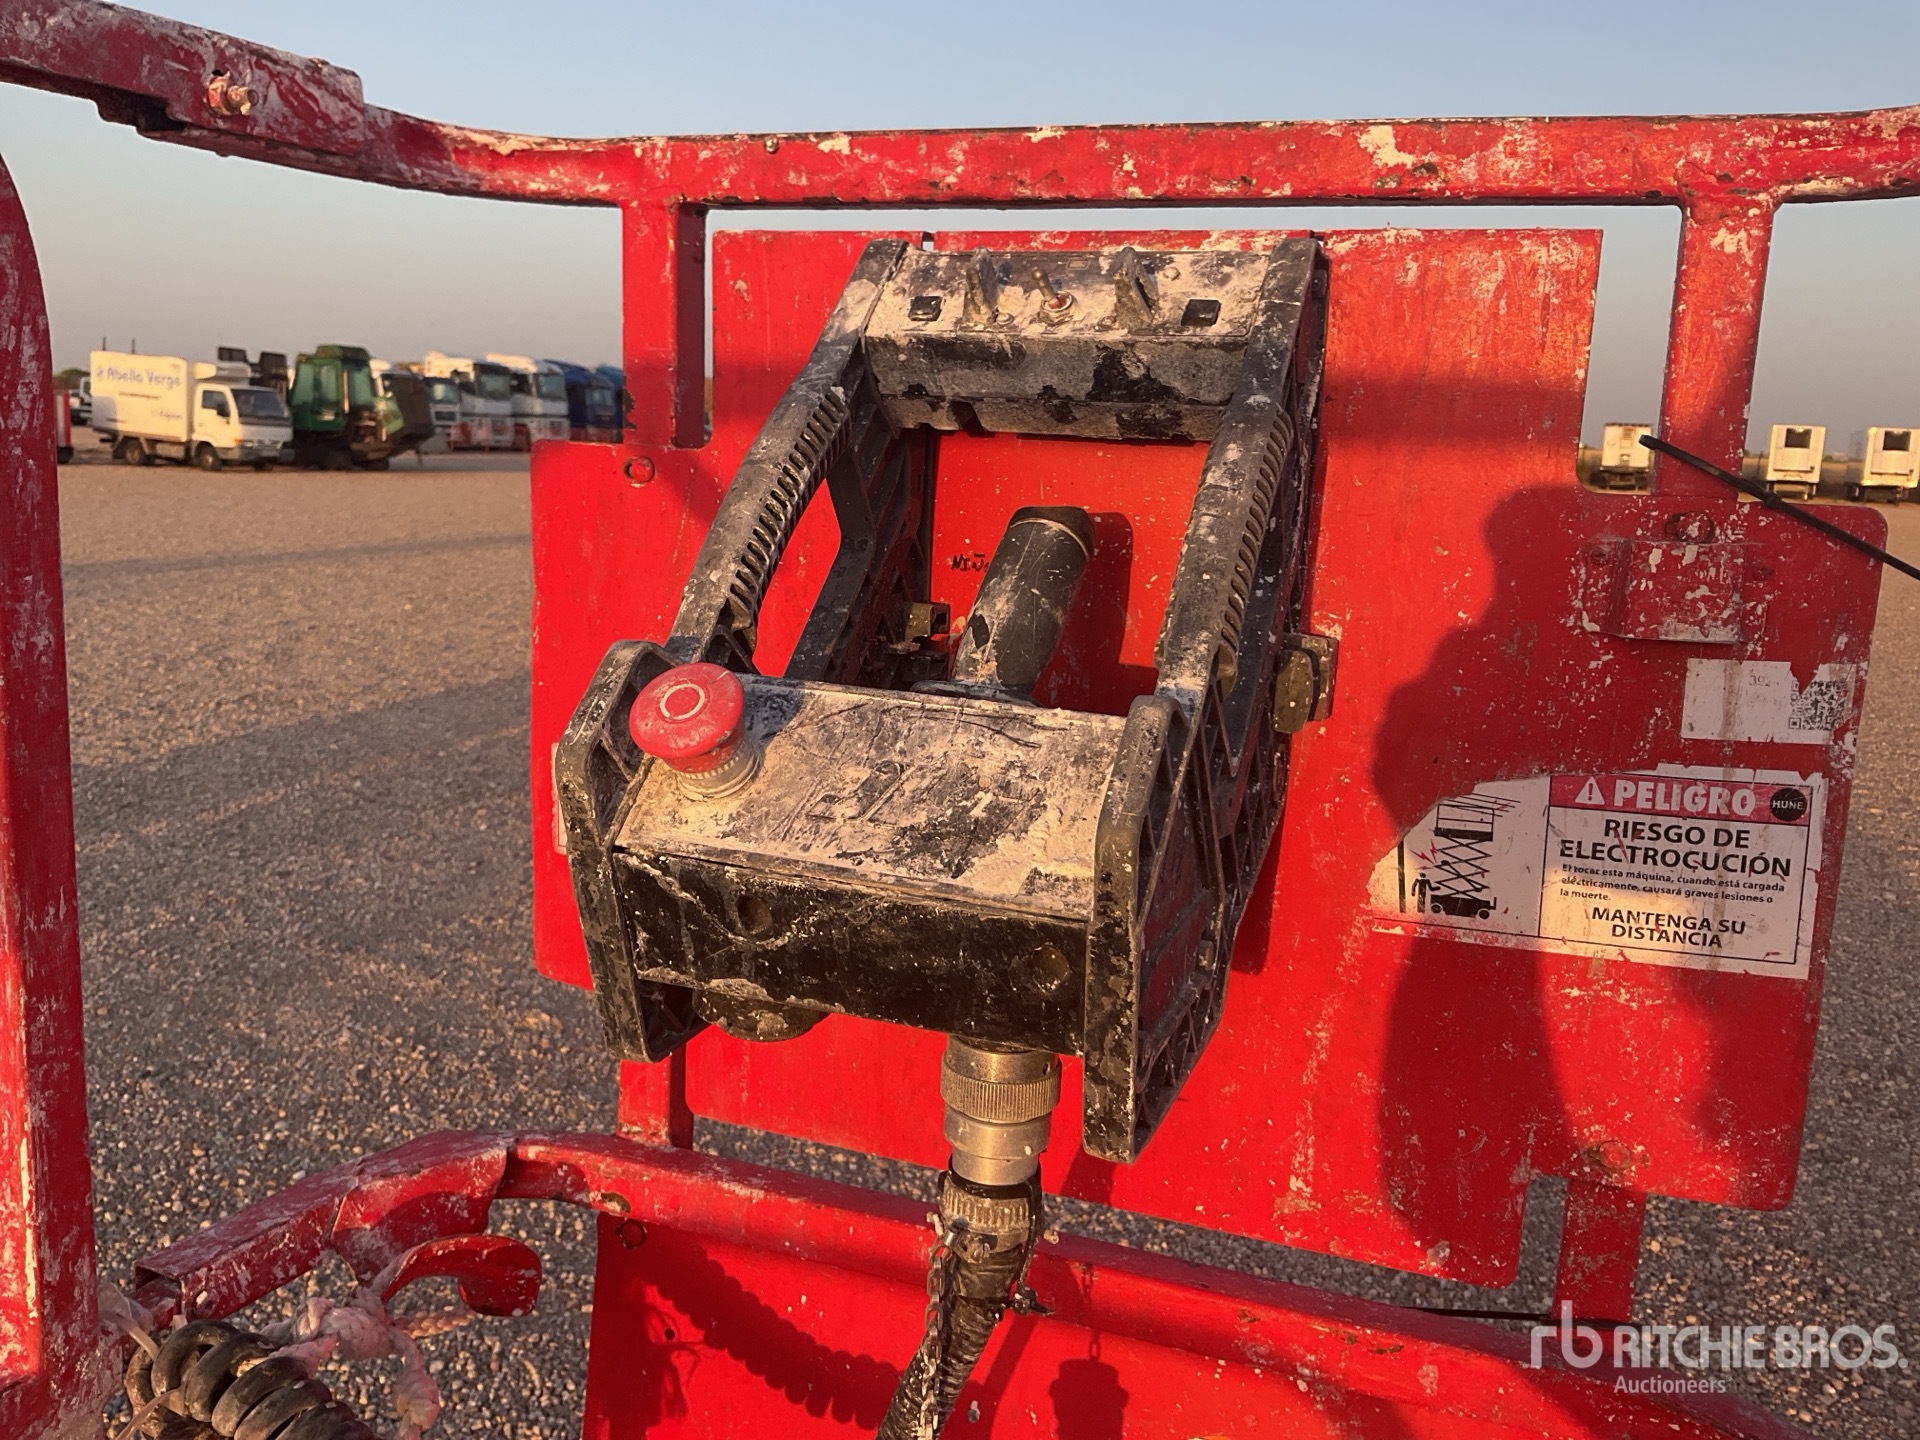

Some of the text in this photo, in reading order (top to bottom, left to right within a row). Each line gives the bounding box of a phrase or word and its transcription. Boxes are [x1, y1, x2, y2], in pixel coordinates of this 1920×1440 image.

[1613, 779, 1756, 817] PELIGRO
[1771, 799, 1804, 810] HUNE
[1604, 818, 1751, 849] RIESGO DE
[1559, 839, 1791, 877] ELECTROCUCIÓN
[1561, 875, 1640, 892] eléctricamente,
[1642, 885, 1682, 896] causará
[1684, 889, 1719, 899] graves
[1721, 890, 1764, 903] lesiones
[1573, 864, 1600, 875] tocar
[1602, 867, 1624, 878] esta
[1625, 870, 1675, 884] máquina,
[1677, 875, 1716, 886] cuando
[1718, 879, 1740, 889] está
[1742, 882, 1785, 893] cargada
[1560, 888, 1611, 901] la muerte.
[1591, 906, 1746, 934] MANTENGA SU
[1611, 924, 1723, 948] DISTANCIA
